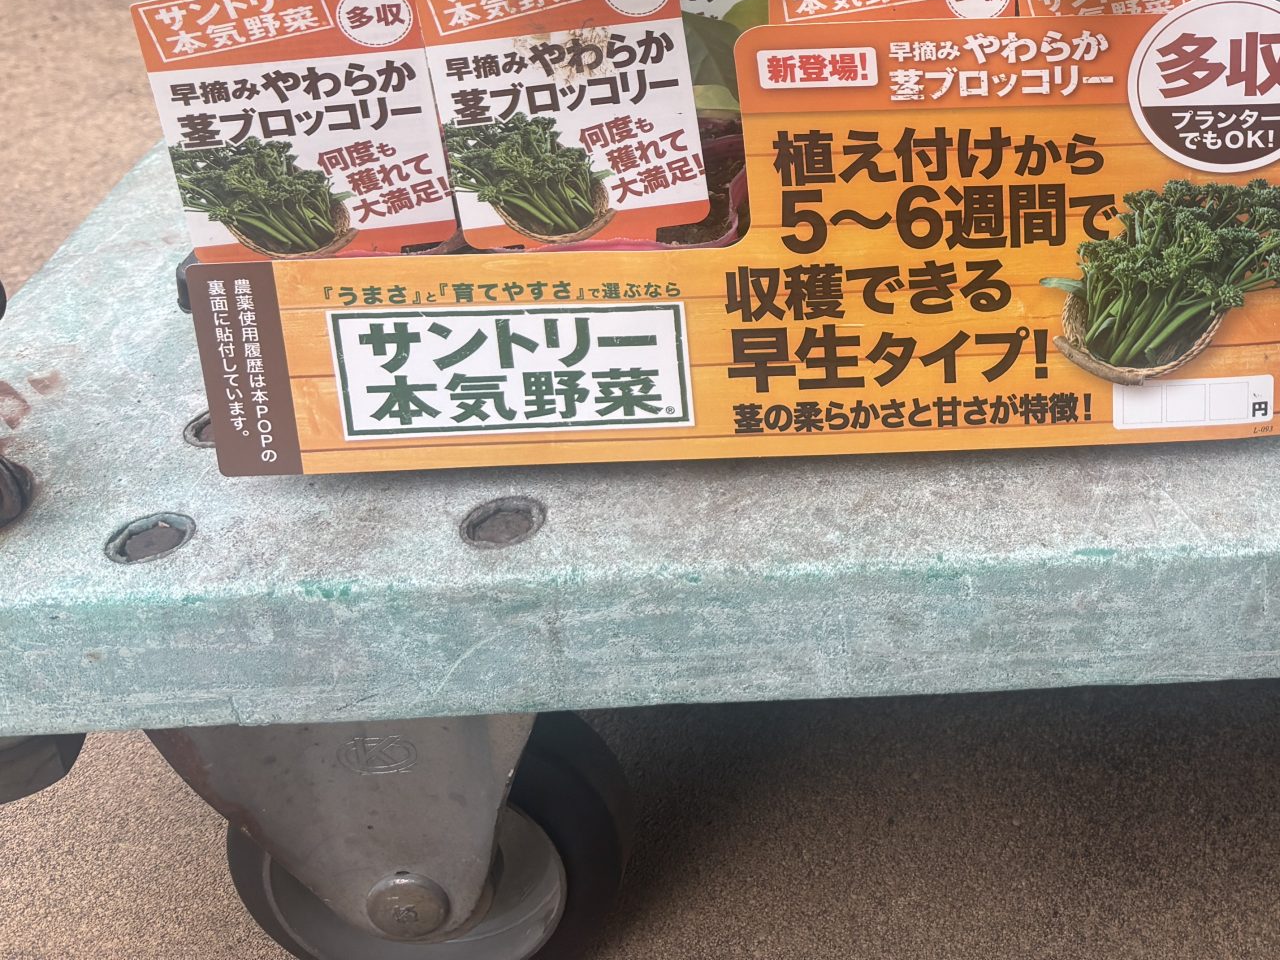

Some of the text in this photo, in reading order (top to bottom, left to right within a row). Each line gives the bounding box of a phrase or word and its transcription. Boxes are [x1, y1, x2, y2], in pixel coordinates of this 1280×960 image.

[166, 5, 320, 55] 本気野菜
[345, 3, 405, 29] 多収
[446, 29, 675, 81] 早摘みやわらか
[767, 52, 868, 83] 新登場!
[888, 30, 1109, 65] 早摘みやわらか
[170, 59, 417, 106] 早摘みやわらか
[451, 69, 679, 126] 茎ブロッコリー
[889, 65, 1114, 101] 茎ブロッコリー
[177, 97, 422, 149] 茎ブロッコリー
[579, 115, 654, 153] 何度も
[1178, 128, 1275, 150] でもOK!
[317, 140, 397, 176] 何度も
[346, 152, 433, 196] 獲れて
[607, 128, 689, 173] 獲れて
[773, 126, 1105, 187] 植え付けから
[352, 176, 451, 223] 大満足!
[611, 154, 706, 203] 大満足!
[724, 260, 1012, 323] 収穫できる
[207, 279, 250, 437] 裏面に貼付しています。
[358, 317, 658, 373] サントリー
[727, 327, 1050, 395] 早生タイプ!
[234, 278, 277, 463] 農薬使用履歴は本POPの
[366, 367, 665, 425] 本気野菜
[733, 392, 1093, 435] 茎の柔らかさと甘さが特徴!
[1252, 401, 1268, 417] 円
